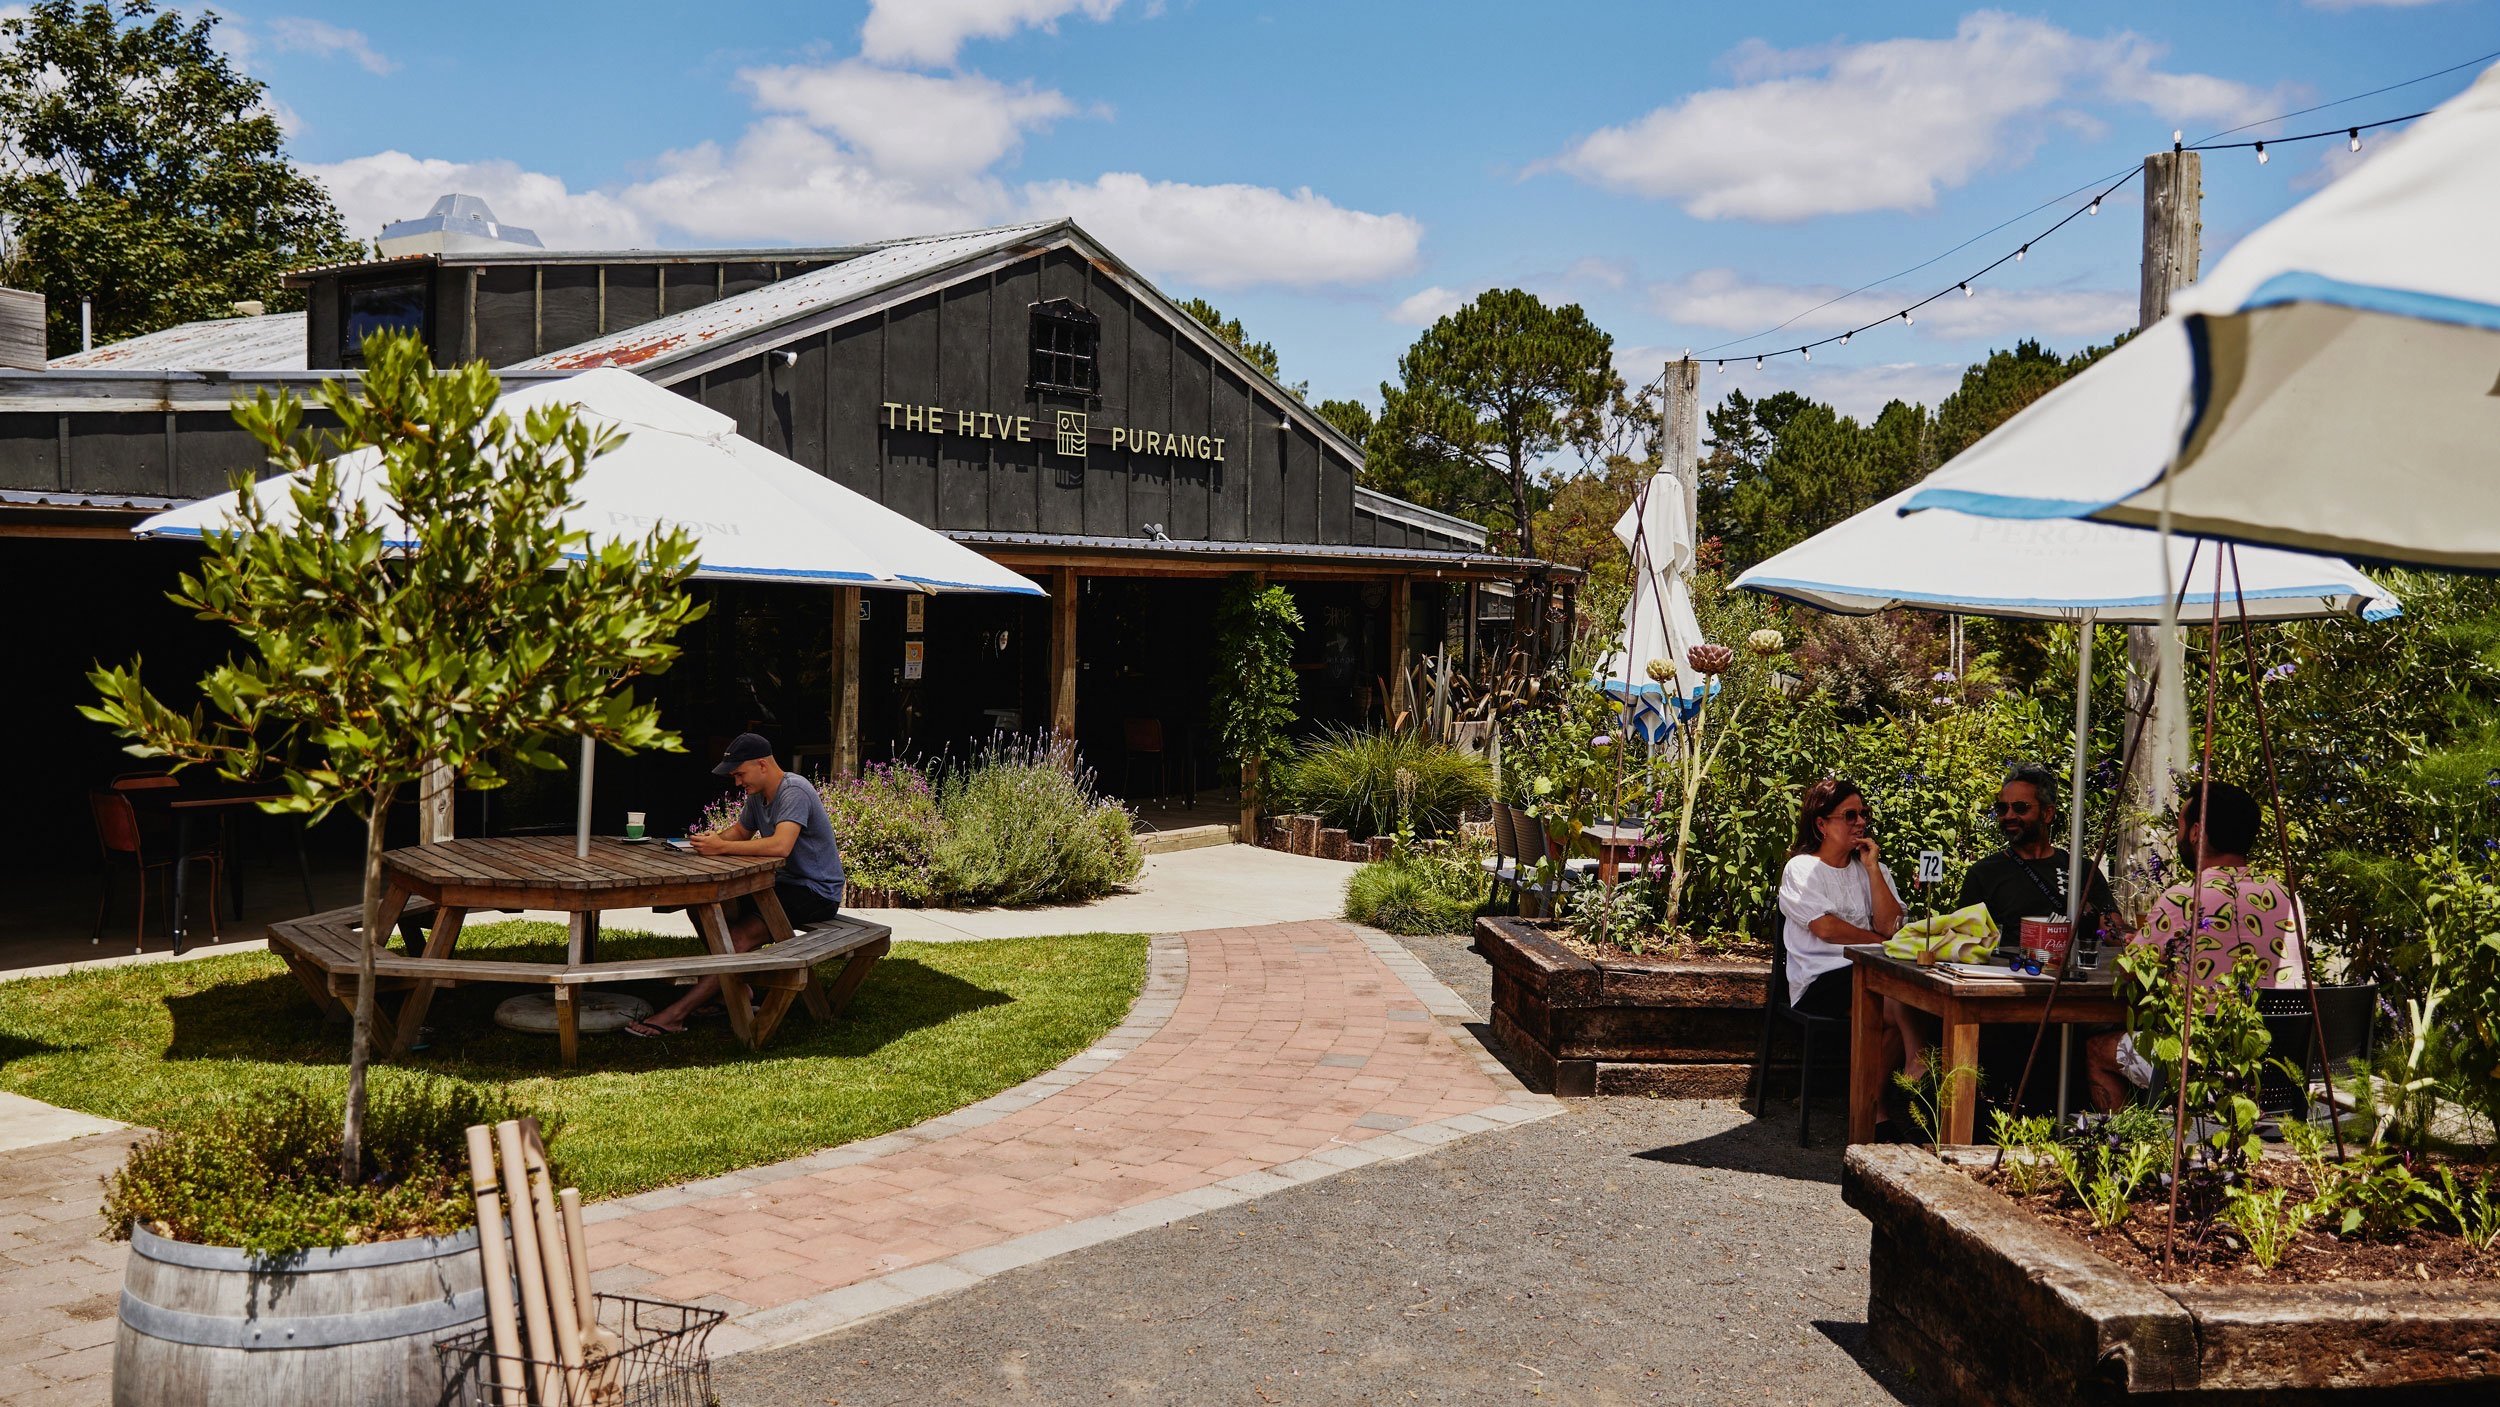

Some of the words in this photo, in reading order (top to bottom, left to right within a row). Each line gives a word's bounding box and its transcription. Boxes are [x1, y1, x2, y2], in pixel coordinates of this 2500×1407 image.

[883, 402, 944, 434] THE
[958, 410, 1031, 442] HIVE
[1112, 427, 1225, 461] PURANGI
[608, 511, 742, 536] PERONI
[1323, 605, 1351, 628] SHOP
[1923, 856, 1940, 876] 72
[2037, 881, 2050, 896] THE
